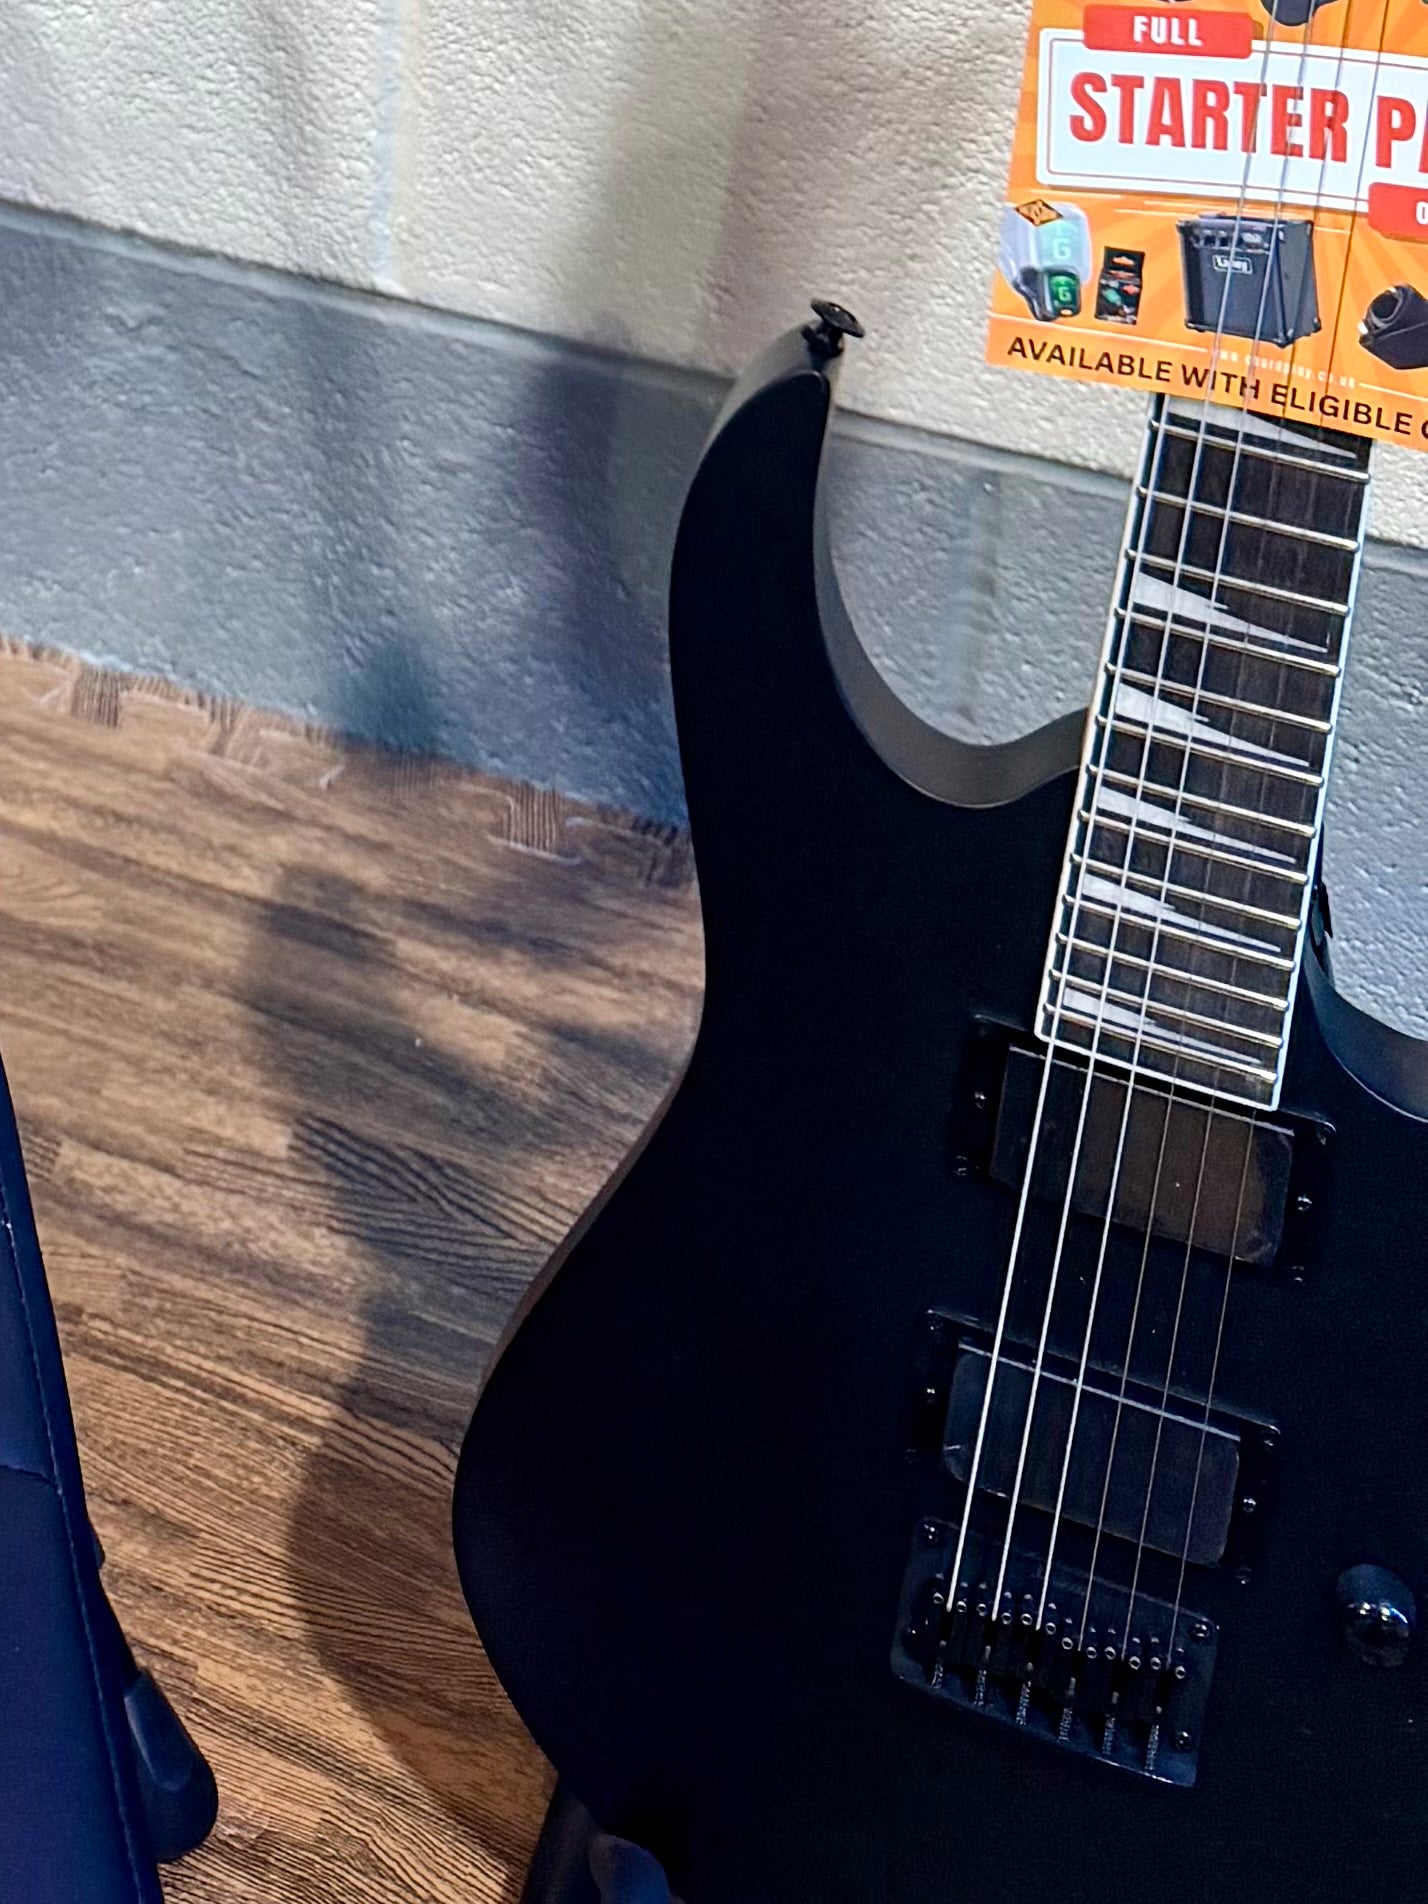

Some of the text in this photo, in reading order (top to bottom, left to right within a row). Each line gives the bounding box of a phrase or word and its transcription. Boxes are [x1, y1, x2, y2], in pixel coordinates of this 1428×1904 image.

[1133, 14, 1203, 47] FULL
[1068, 70, 1350, 164] STARTER
[1006, 335, 1174, 384] AVAILABLE
[1180, 363, 1261, 400] WITH
[1270, 382, 1413, 435] ELIGIBLE
